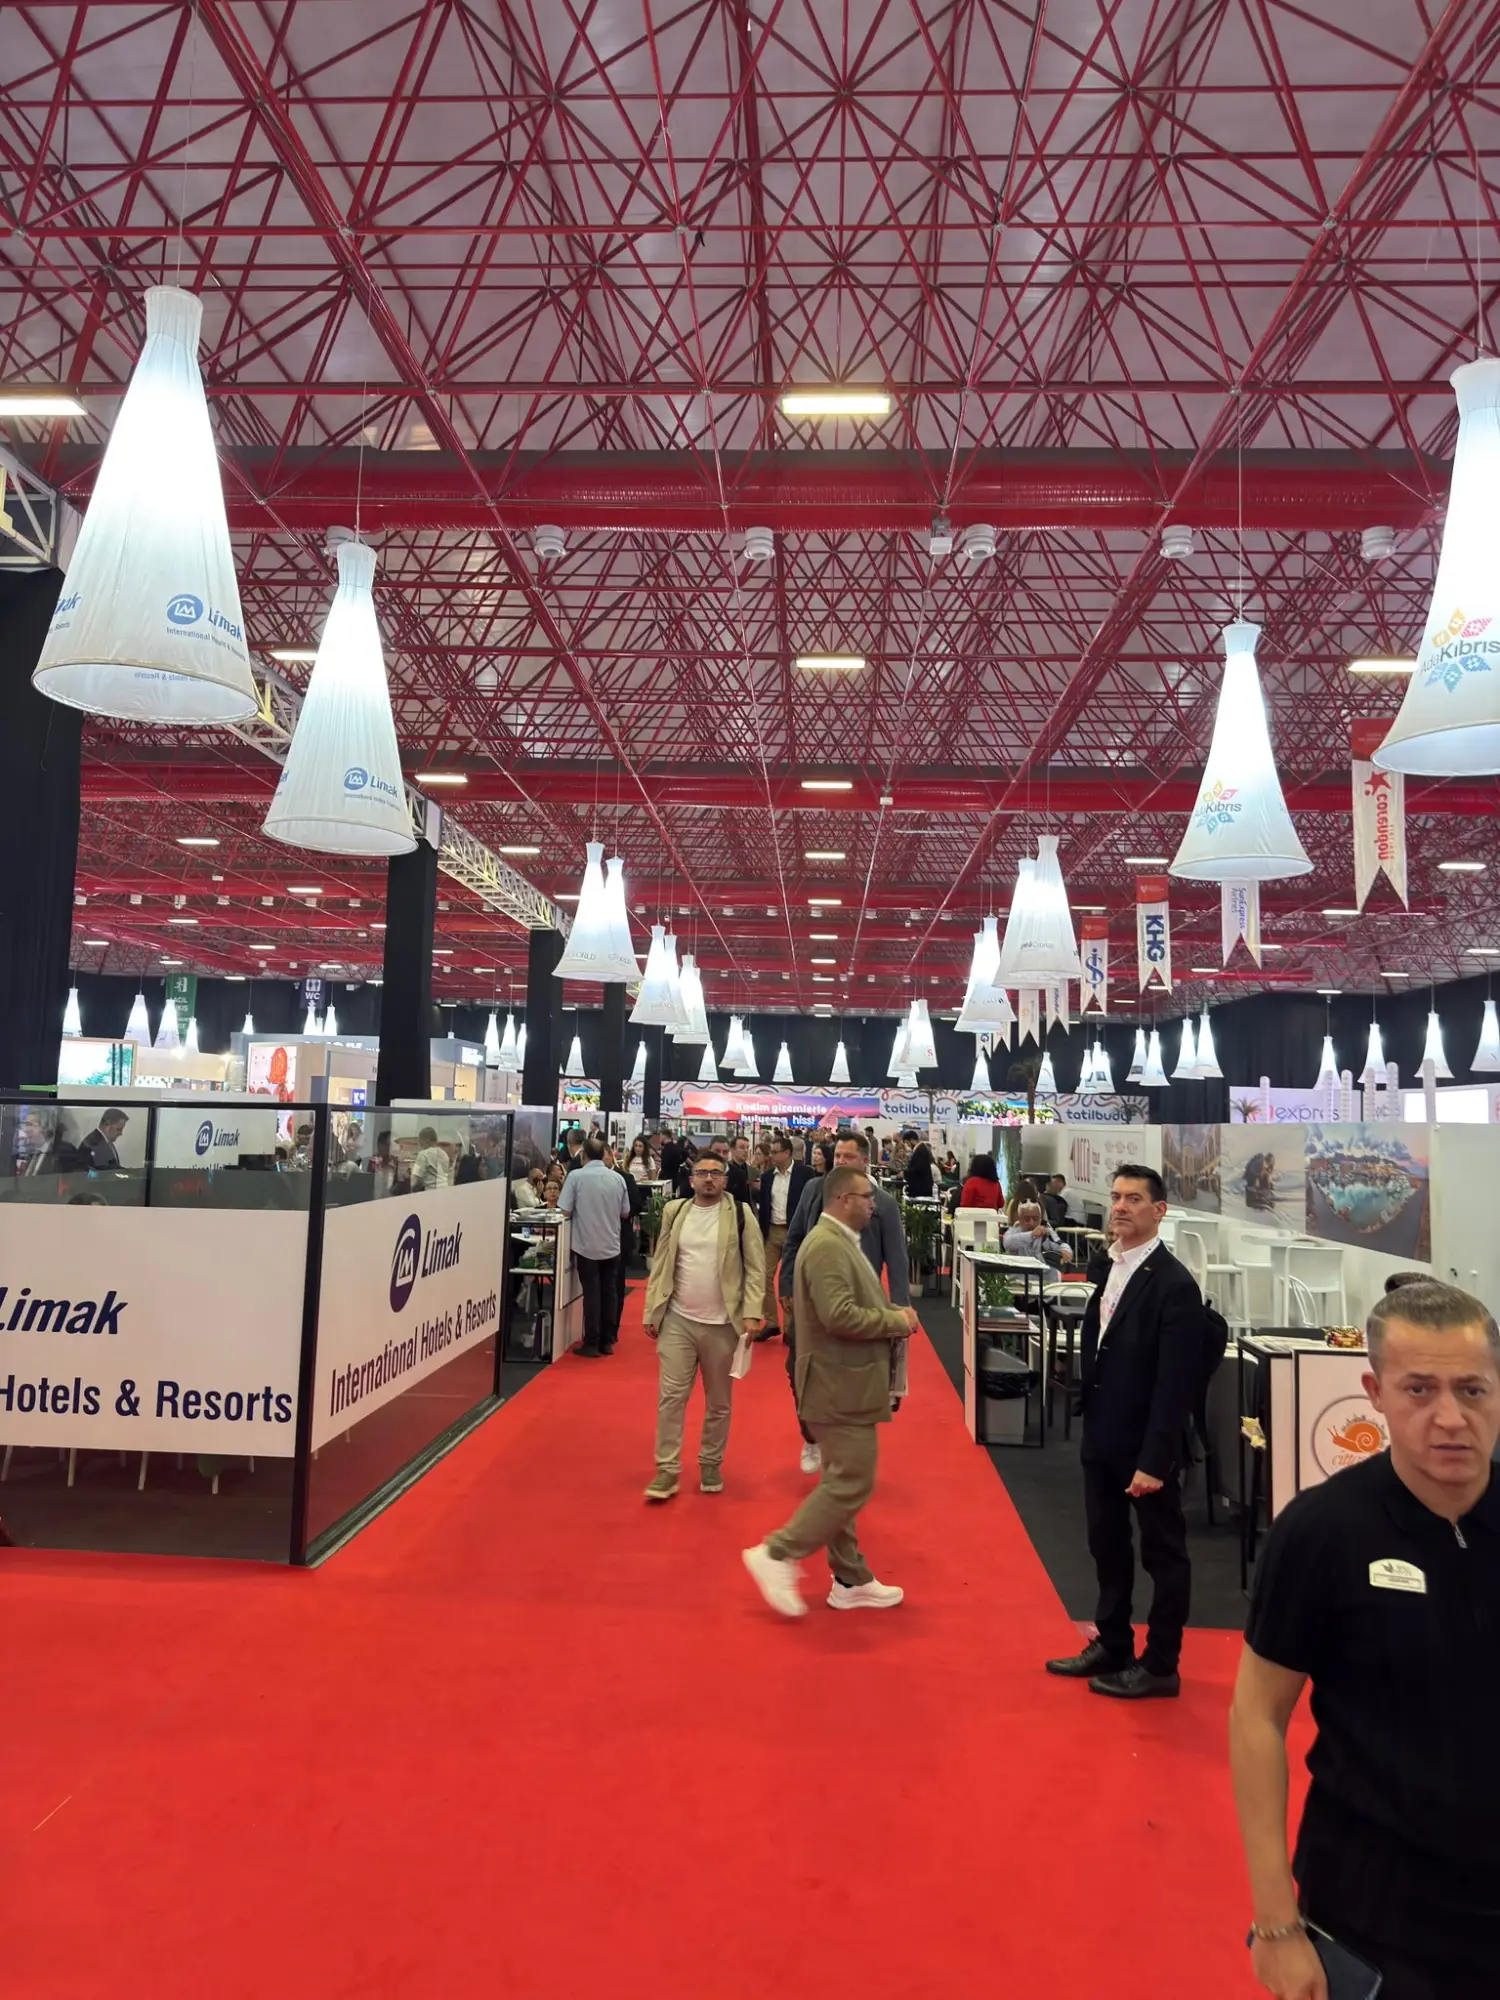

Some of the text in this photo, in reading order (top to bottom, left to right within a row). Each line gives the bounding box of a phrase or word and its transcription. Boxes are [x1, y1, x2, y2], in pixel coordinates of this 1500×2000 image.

[207, 607, 242, 642] Limak
[370, 775, 398, 798] Limak
[1145, 915, 1165, 962] KHG
[305, 992, 320, 1000] WC
[213, 1128, 240, 1147] Limak
[421, 1222, 463, 1278] Limak
[330, 1289, 497, 1417] International Hotels & Resorts
[0, 1374, 293, 1424] Hotels & Resorts
